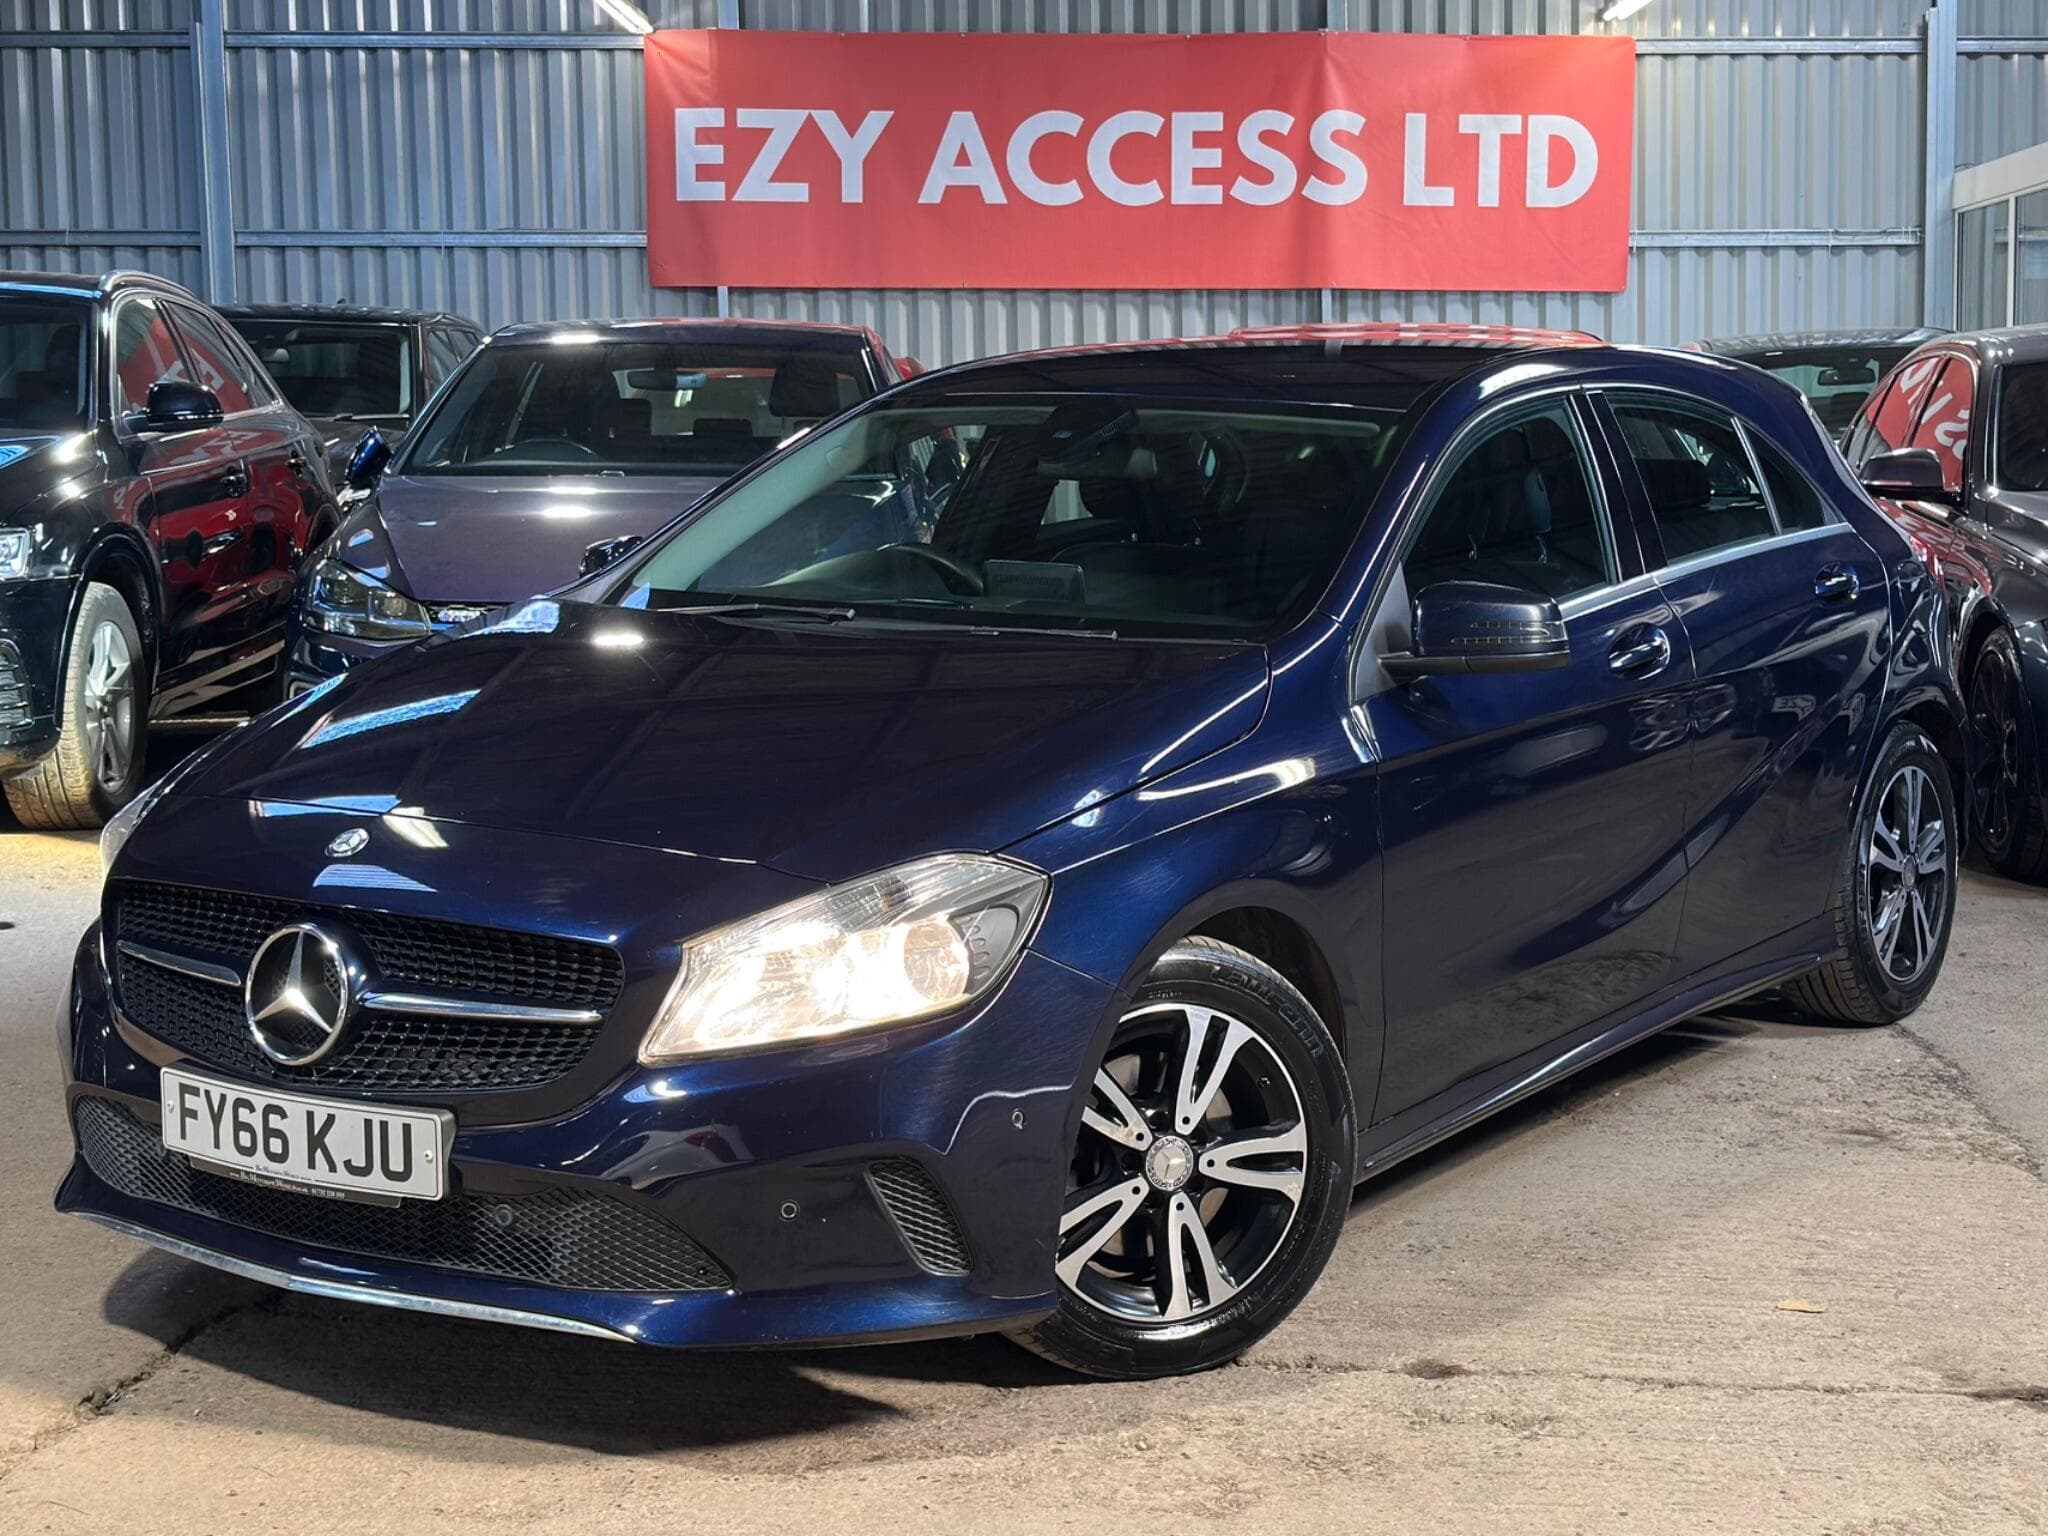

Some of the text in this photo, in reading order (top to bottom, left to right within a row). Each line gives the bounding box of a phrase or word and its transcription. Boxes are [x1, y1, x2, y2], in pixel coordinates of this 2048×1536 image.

[674, 106, 1599, 209] EZY ACCESS LTD
[178, 1083, 413, 1183] FY66 KJU
